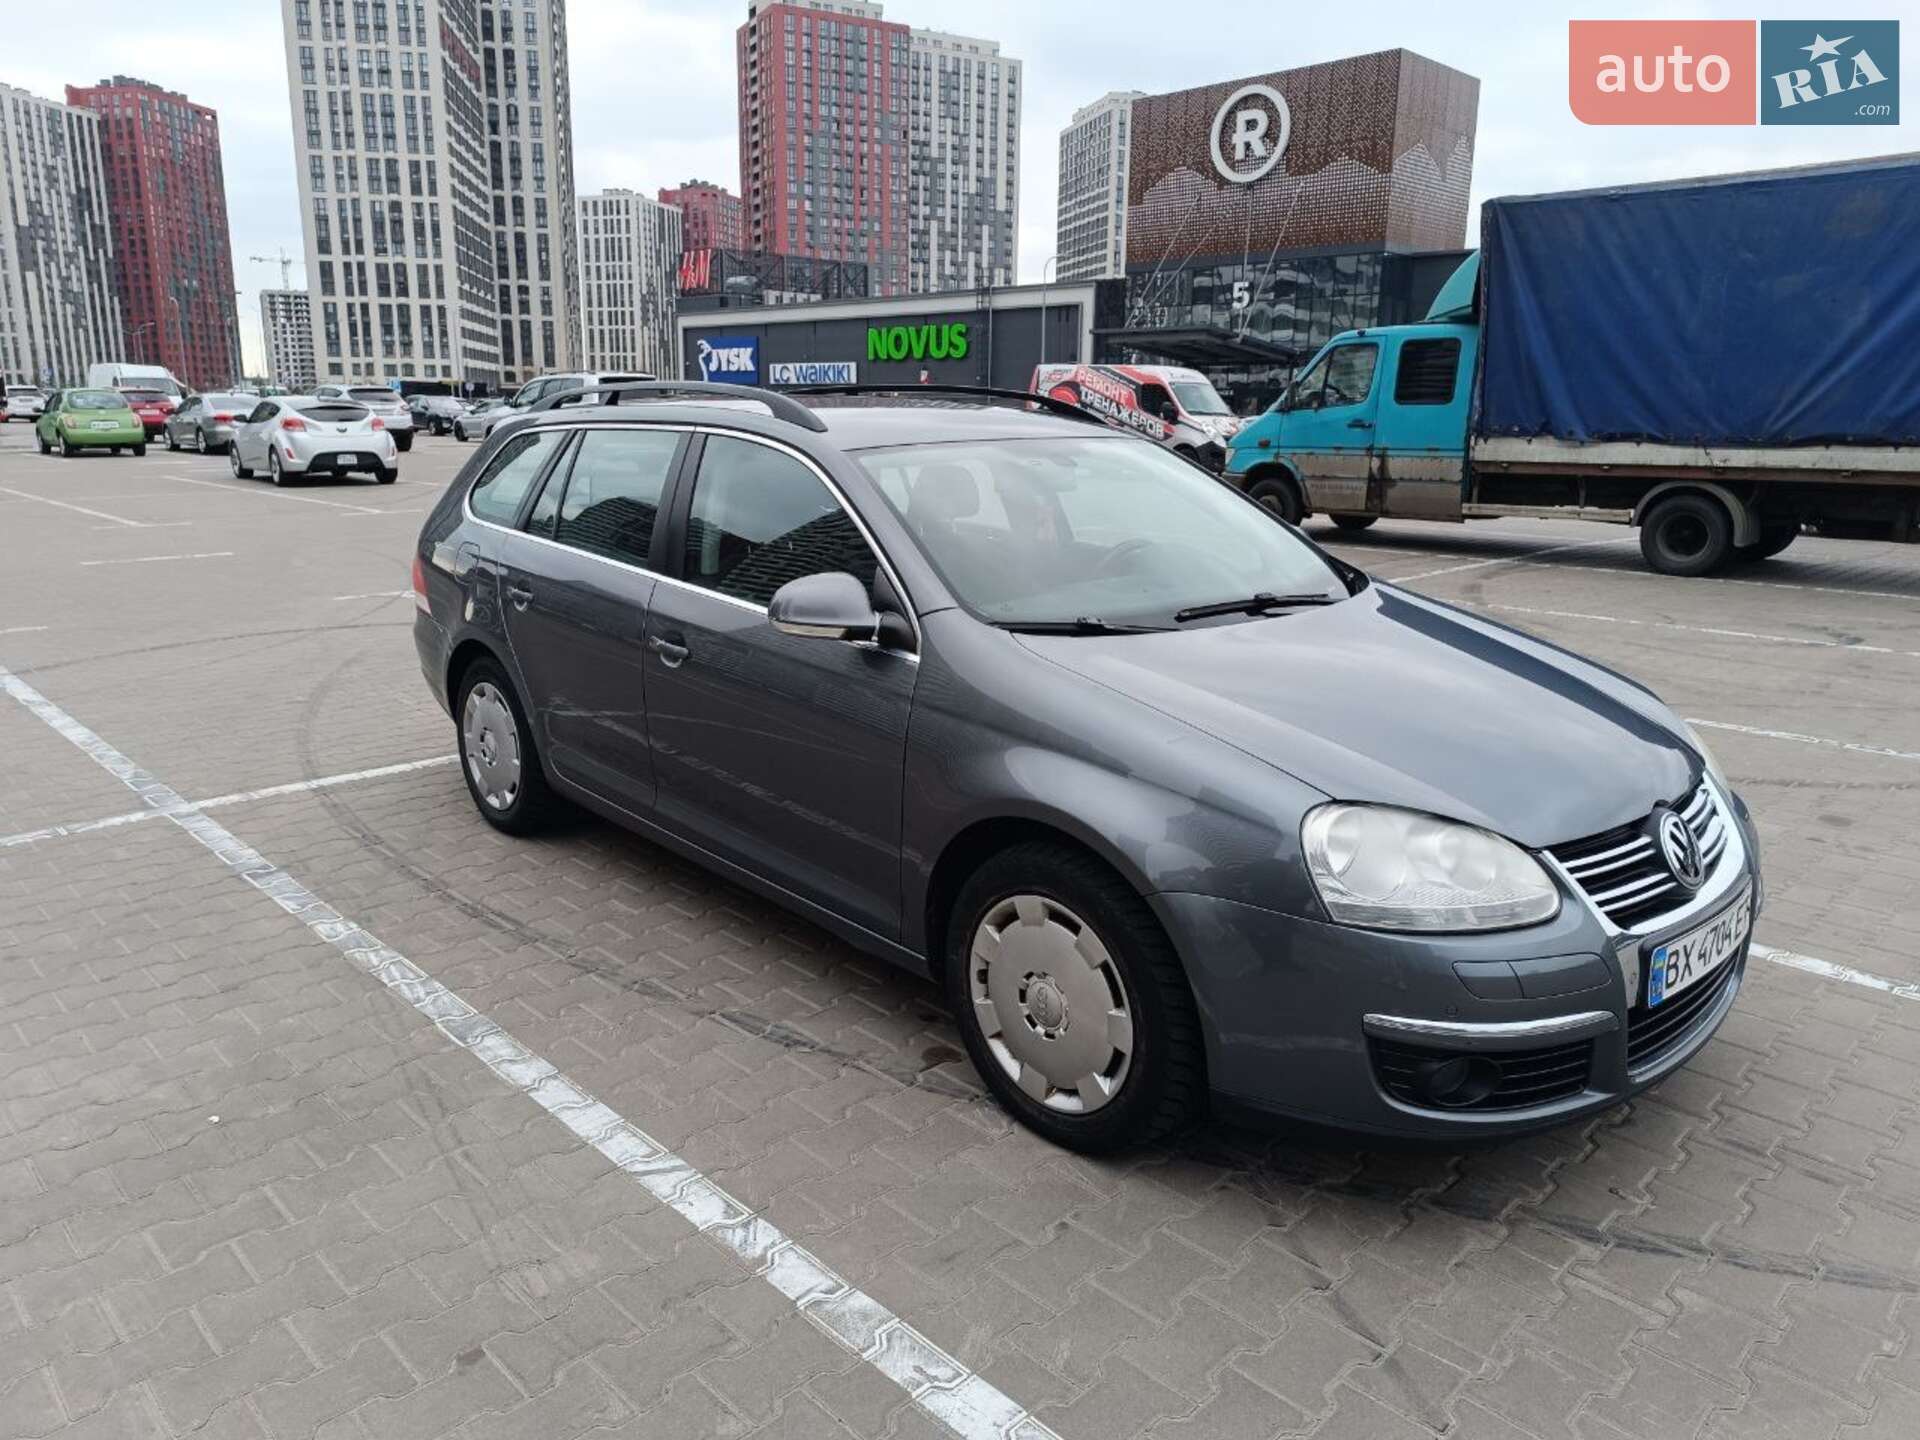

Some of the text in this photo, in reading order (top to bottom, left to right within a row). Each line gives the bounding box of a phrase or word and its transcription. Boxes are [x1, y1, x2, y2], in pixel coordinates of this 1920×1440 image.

[1232, 282, 1250, 309] 5
[709, 347, 756, 372] JYSK
[867, 323, 968, 361] NOVUS
[772, 366, 791, 383] LC
[1077, 368, 1130, 405] РЕМОНТ
[1080, 386, 1165, 440] ТРЕНАЖЕРОВ
[1697, 911, 1736, 967] 4704
